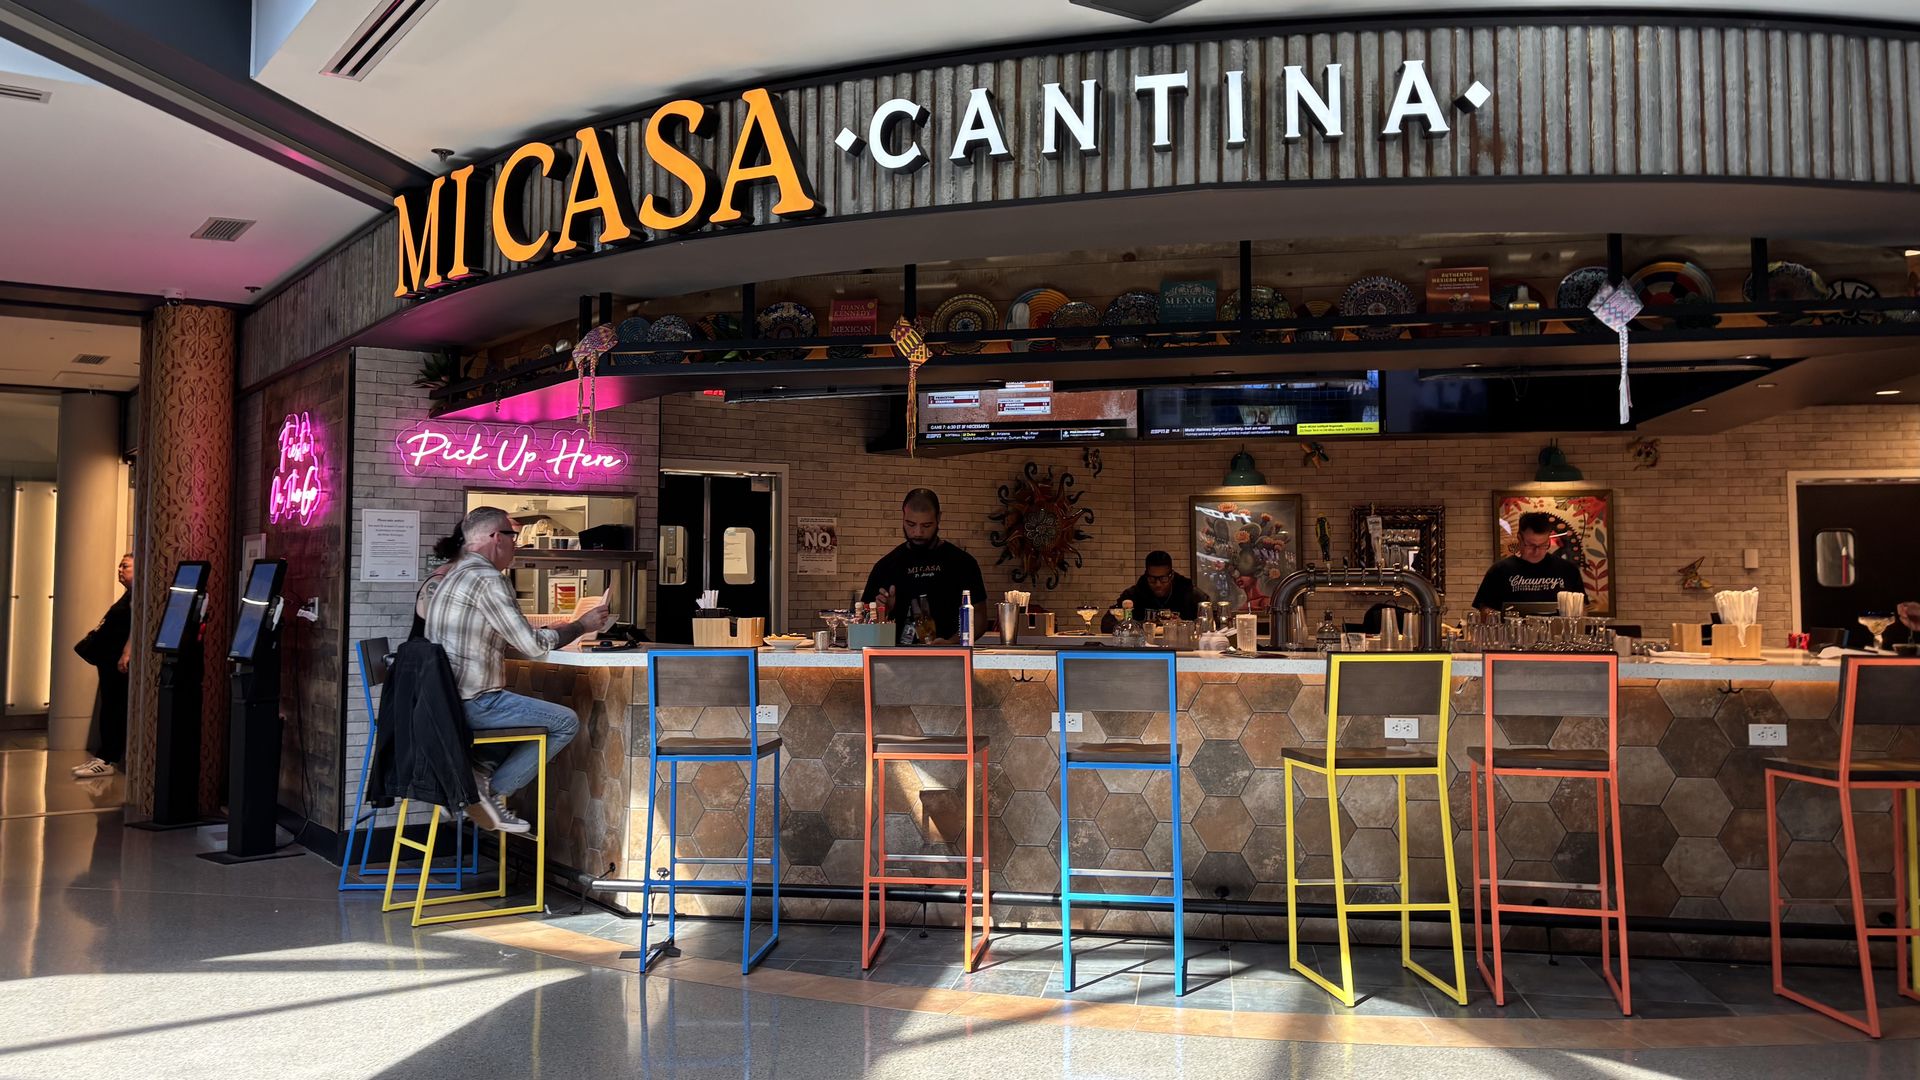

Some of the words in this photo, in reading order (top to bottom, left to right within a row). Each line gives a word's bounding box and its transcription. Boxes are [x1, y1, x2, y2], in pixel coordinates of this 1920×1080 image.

[868, 59, 1450, 170] CANTINA
[394, 164, 476, 298] MI
[492, 87, 815, 263] CASA
[1165, 297, 1215, 305] MEXICO
[831, 325, 871, 333] MEXICAN
[406, 429, 488, 467] Pick
[496, 434, 537, 476] Up
[546, 438, 622, 479] Here
[804, 531, 831, 547] NO
[1509, 574, 1565, 589] Chauncy's
